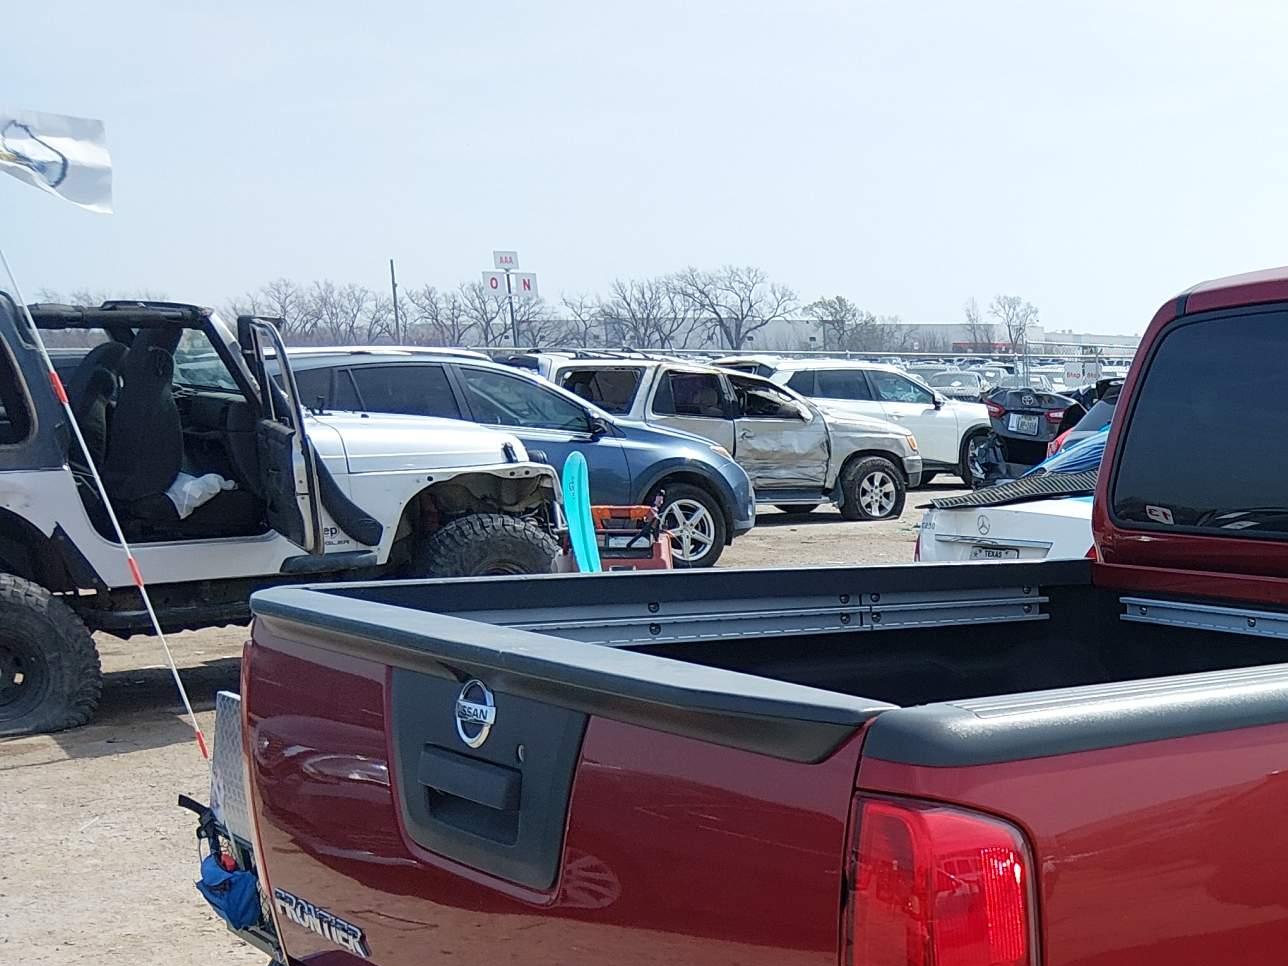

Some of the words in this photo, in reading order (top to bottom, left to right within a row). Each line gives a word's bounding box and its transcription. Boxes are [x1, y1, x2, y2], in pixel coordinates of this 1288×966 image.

[522, 278, 531, 291] N
[323, 527, 338, 537] ep
[984, 550, 1002, 558] TEXAS
[274, 887, 370, 958] FRONTIER
